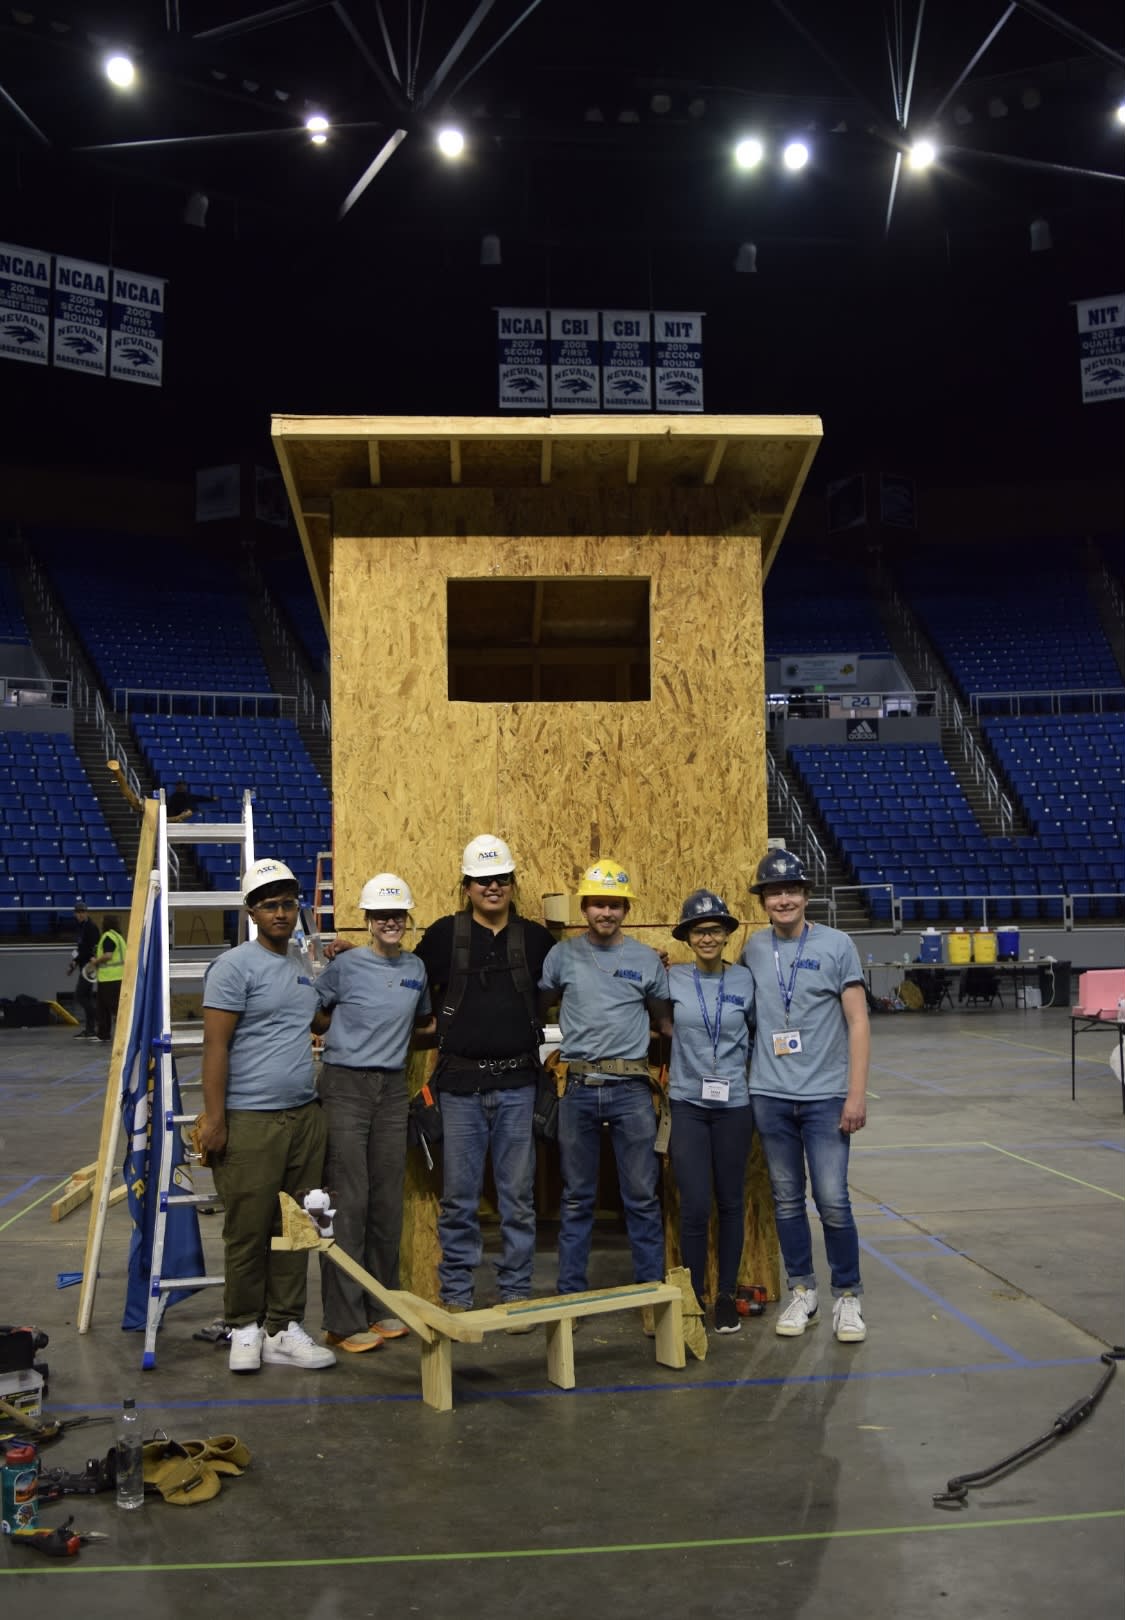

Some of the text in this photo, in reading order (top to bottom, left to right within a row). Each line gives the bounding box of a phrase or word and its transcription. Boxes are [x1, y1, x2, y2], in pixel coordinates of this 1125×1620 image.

[0, 254, 48, 281] NCAA
[58, 267, 106, 294] NCAA
[116, 280, 161, 305] NCAA
[69, 295, 96, 306] 2005
[60, 302, 103, 317] SECOND
[1088, 306, 1119, 325] NIT
[63, 311, 100, 326] ROUND
[123, 315, 153, 327] FIRST
[119, 323, 156, 338] ROUND
[501, 318, 544, 334] NCAA
[561, 319, 589, 335] CBI
[613, 320, 640, 337] CBI
[664, 321, 693, 337] NIT
[57, 325, 104, 346] NEVADA
[114, 336, 159, 357] NEVADA
[511, 340, 535, 348] 2007
[667, 343, 688, 351] 2010
[504, 348, 543, 356] SECOND
[612, 350, 640, 358] FIRST
[657, 351, 701, 359] SECOND
[56, 354, 104, 370] BASKETBALL
[507, 356, 540, 364] ROUND
[558, 357, 592, 365] ROUND
[610, 358, 644, 366] ROUND
[112, 365, 160, 380] BASKETBALL
[502, 367, 544, 380] NEVADA
[554, 367, 596, 381] NEVADA
[607, 369, 648, 382] NEVADA
[659, 370, 700, 384] NEVADA
[851, 696, 870, 707] 24
[848, 731, 877, 740] adidas
